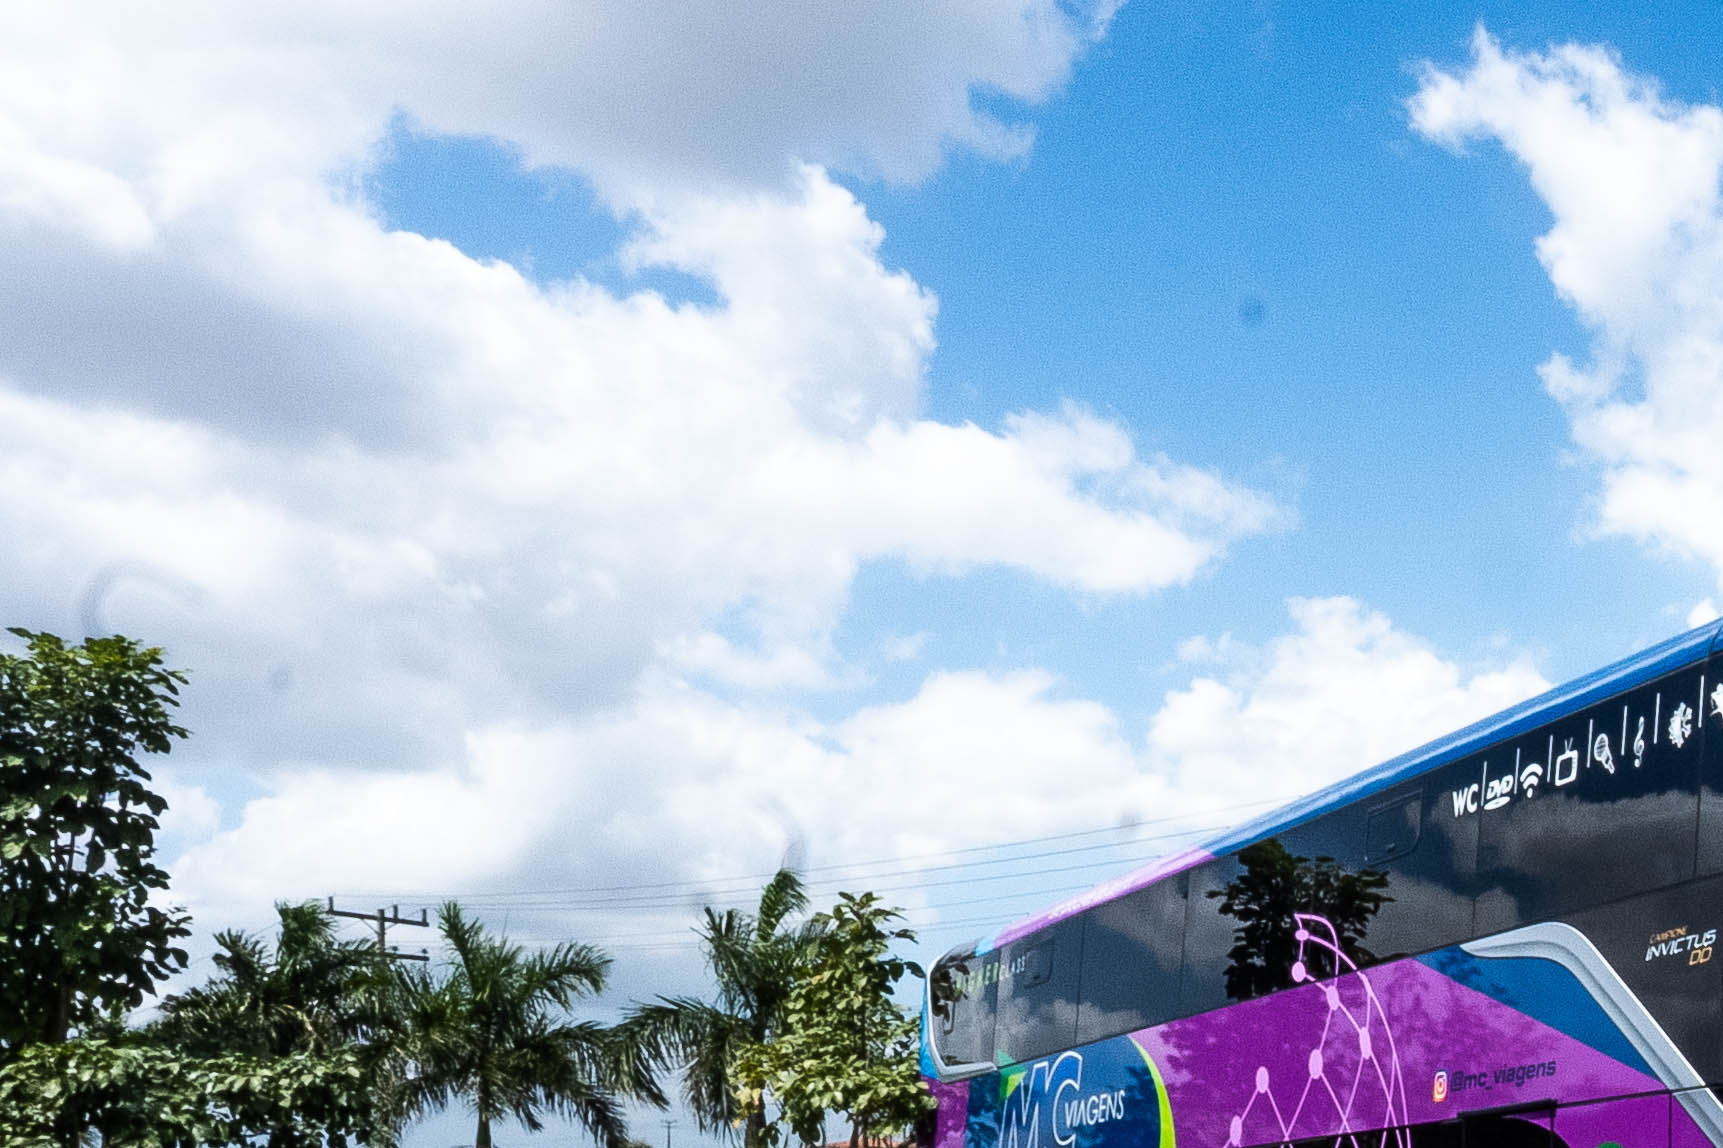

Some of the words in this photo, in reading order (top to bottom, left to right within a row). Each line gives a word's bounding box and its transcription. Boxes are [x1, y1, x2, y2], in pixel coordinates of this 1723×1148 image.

[1452, 783, 1479, 818] WC
[1486, 774, 1514, 800] DVD
[1644, 928, 1718, 962] INVICTUS
[1688, 946, 1713, 966] DD
[1450, 1060, 1557, 1092] @mc_viagens
[1065, 1090, 1126, 1129] VIAGENS
